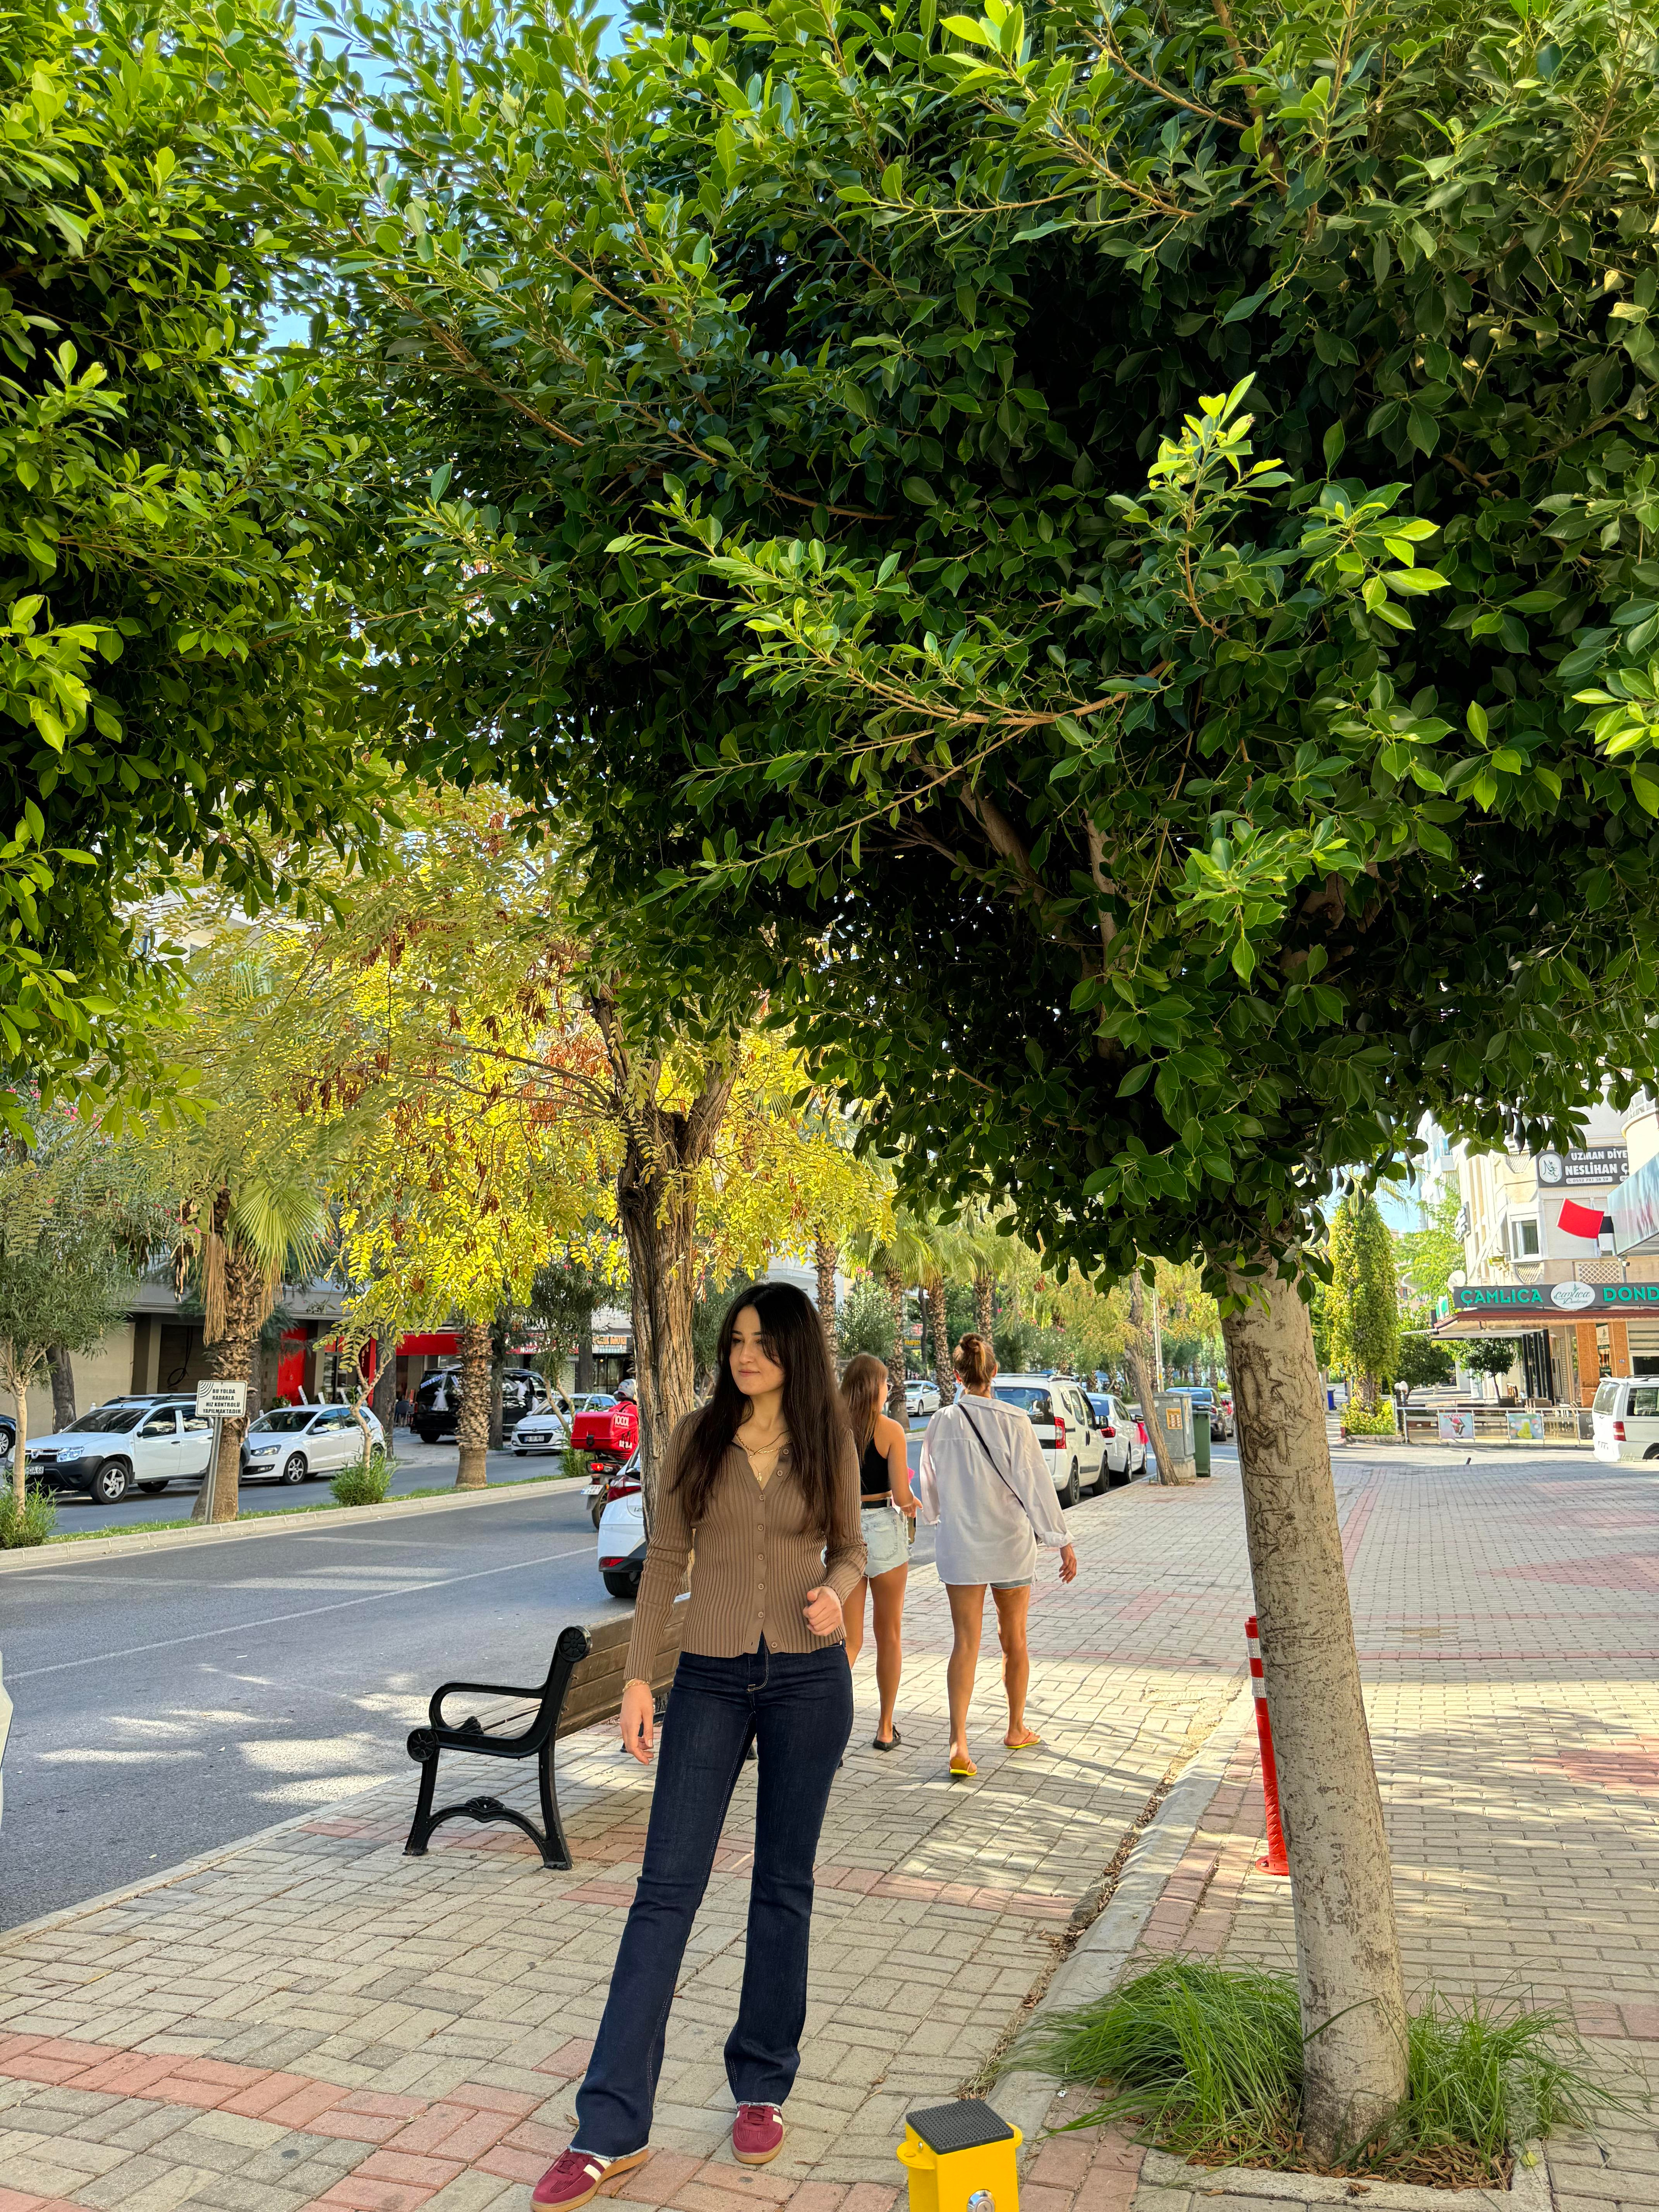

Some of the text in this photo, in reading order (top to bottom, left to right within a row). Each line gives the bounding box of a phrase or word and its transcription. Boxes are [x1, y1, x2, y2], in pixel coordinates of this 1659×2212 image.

[1571, 1151, 1604, 1161] UZMAN
[1565, 1162, 1618, 1176] NESLİHAN
[1461, 1289, 1543, 1307] ÇAMLICA
[1603, 1286, 1659, 1302] DOND
